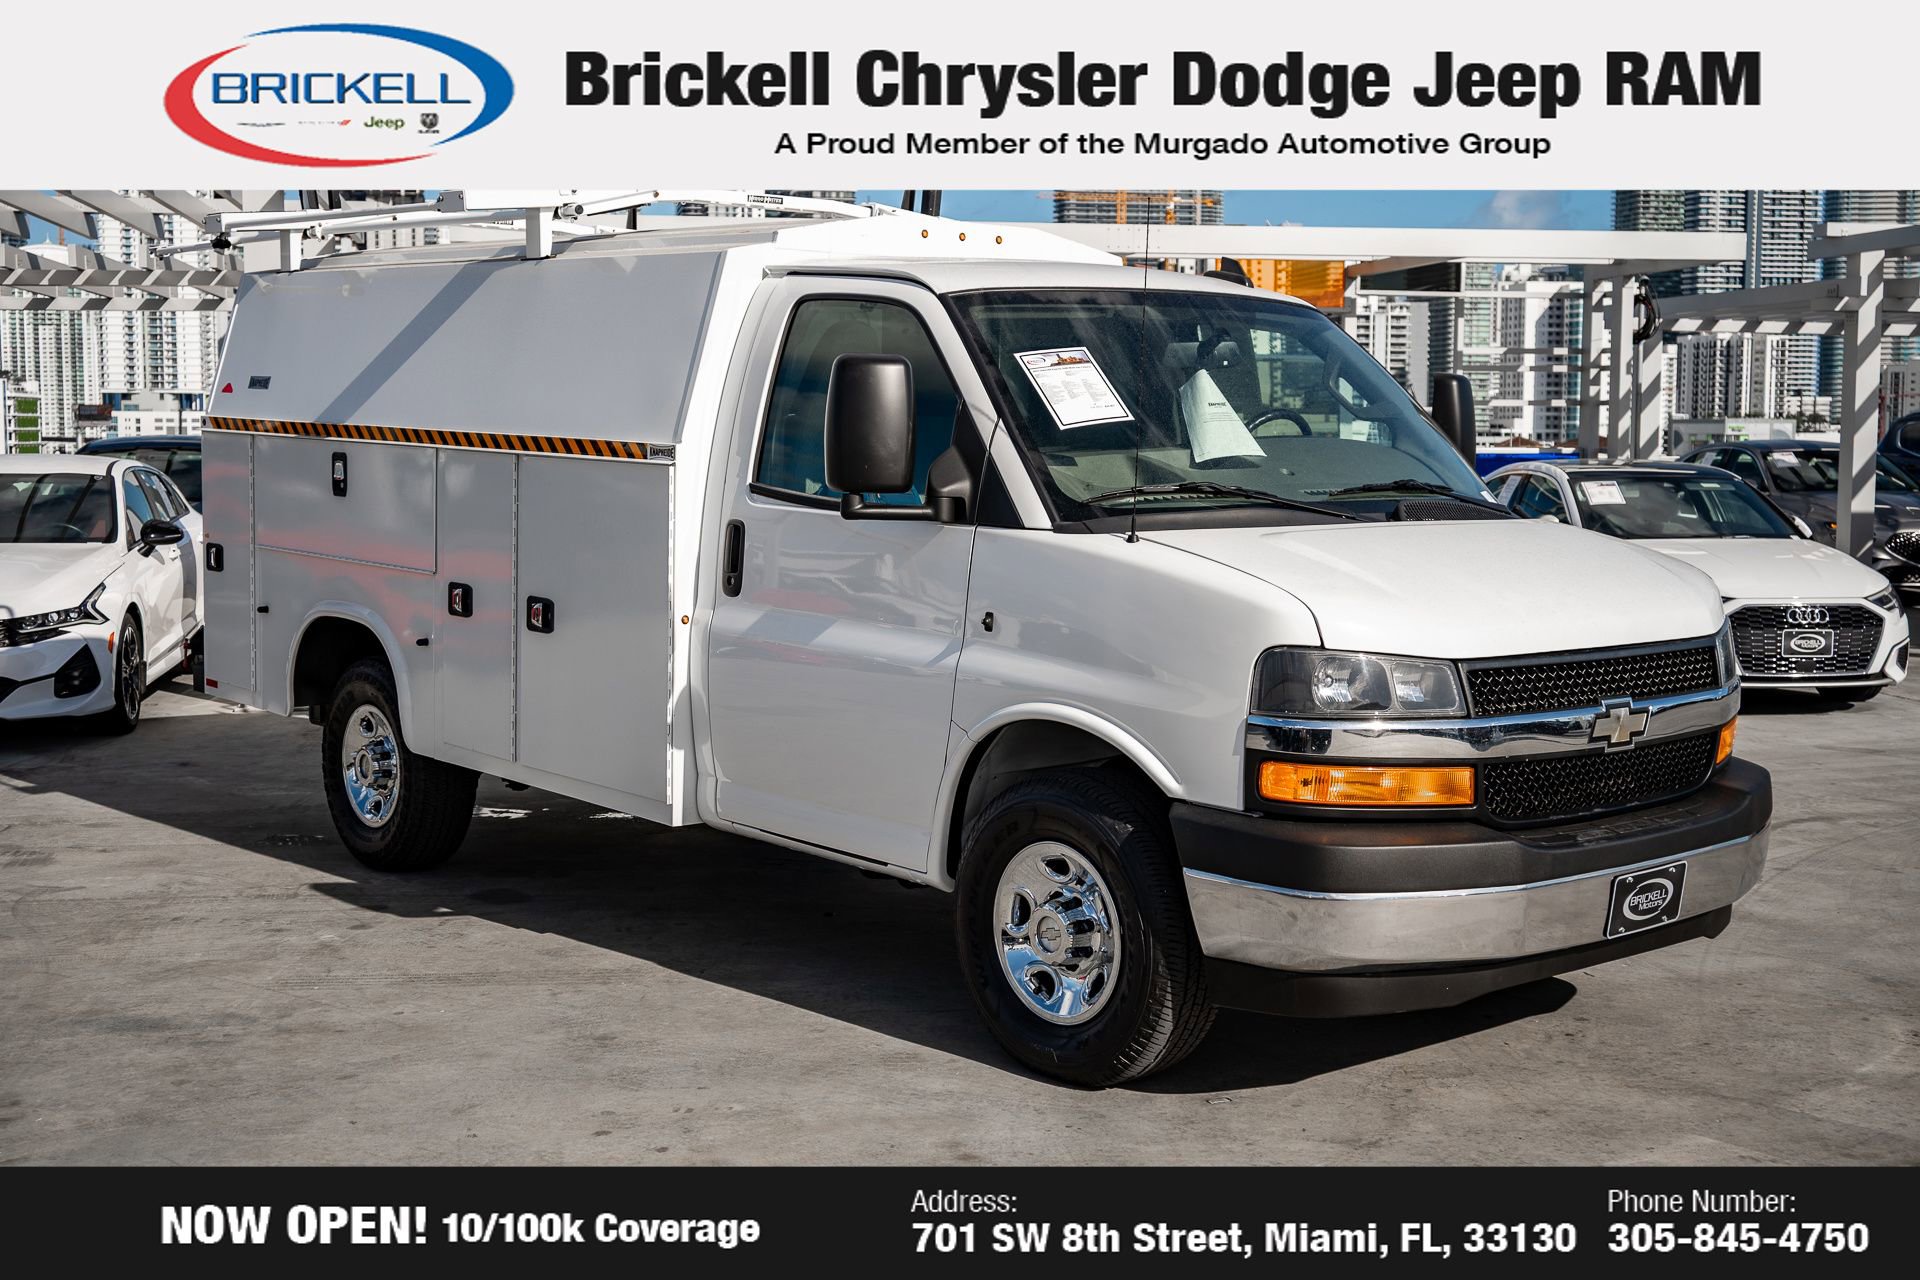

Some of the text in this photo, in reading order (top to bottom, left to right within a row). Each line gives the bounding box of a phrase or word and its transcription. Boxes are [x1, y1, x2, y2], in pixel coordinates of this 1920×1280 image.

[650, 446, 673, 458] KNAPHEIDE
[1630, 889, 1667, 906] BRICKELL
[1639, 900, 1662, 910] Motors
